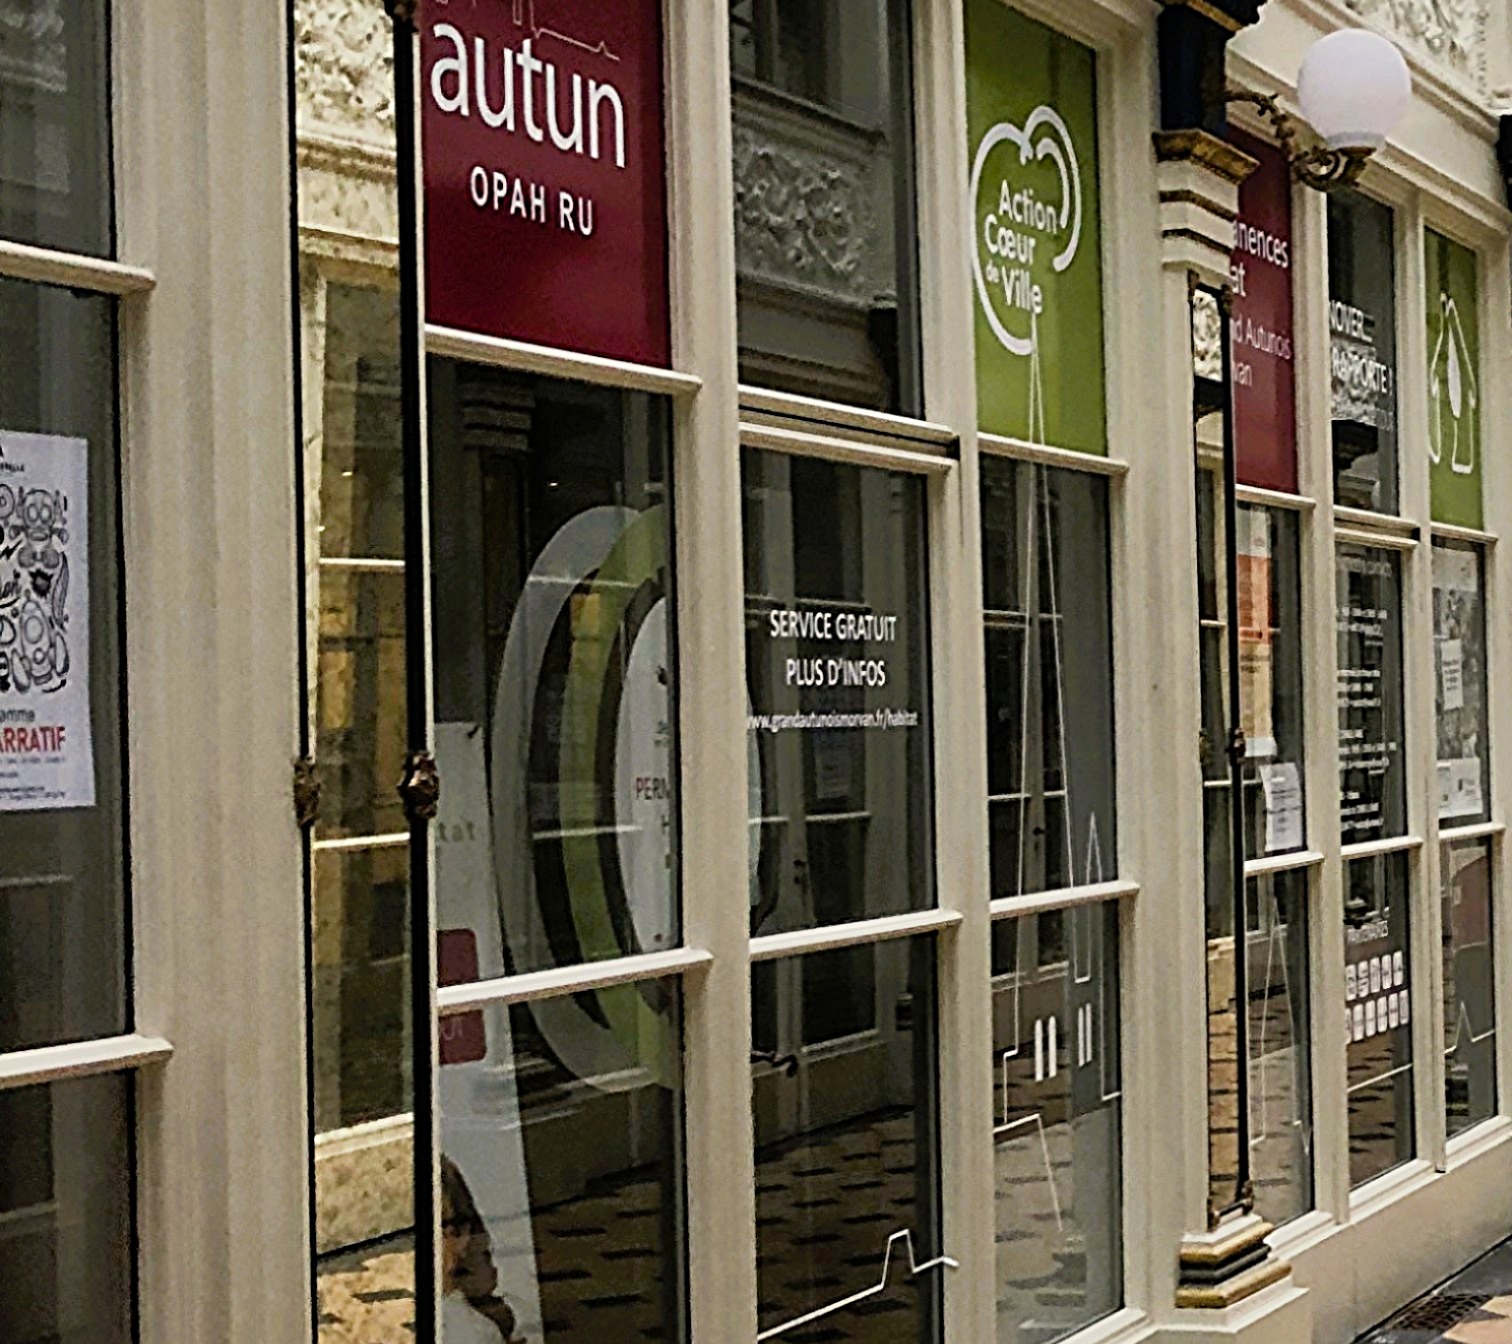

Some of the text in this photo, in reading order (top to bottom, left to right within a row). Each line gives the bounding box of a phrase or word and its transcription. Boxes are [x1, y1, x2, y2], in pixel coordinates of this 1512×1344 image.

[430, 22, 625, 169] autun
[470, 166, 593, 236] OPAH RU
[999, 179, 1057, 234] Action
[1233, 220, 1289, 269] nences
[986, 259, 1042, 314] de Ville
[770, 609, 897, 642] SERVICE GRATUIT
[786, 658, 824, 687] PLUS
[0, 725, 66, 752] RRATIF
